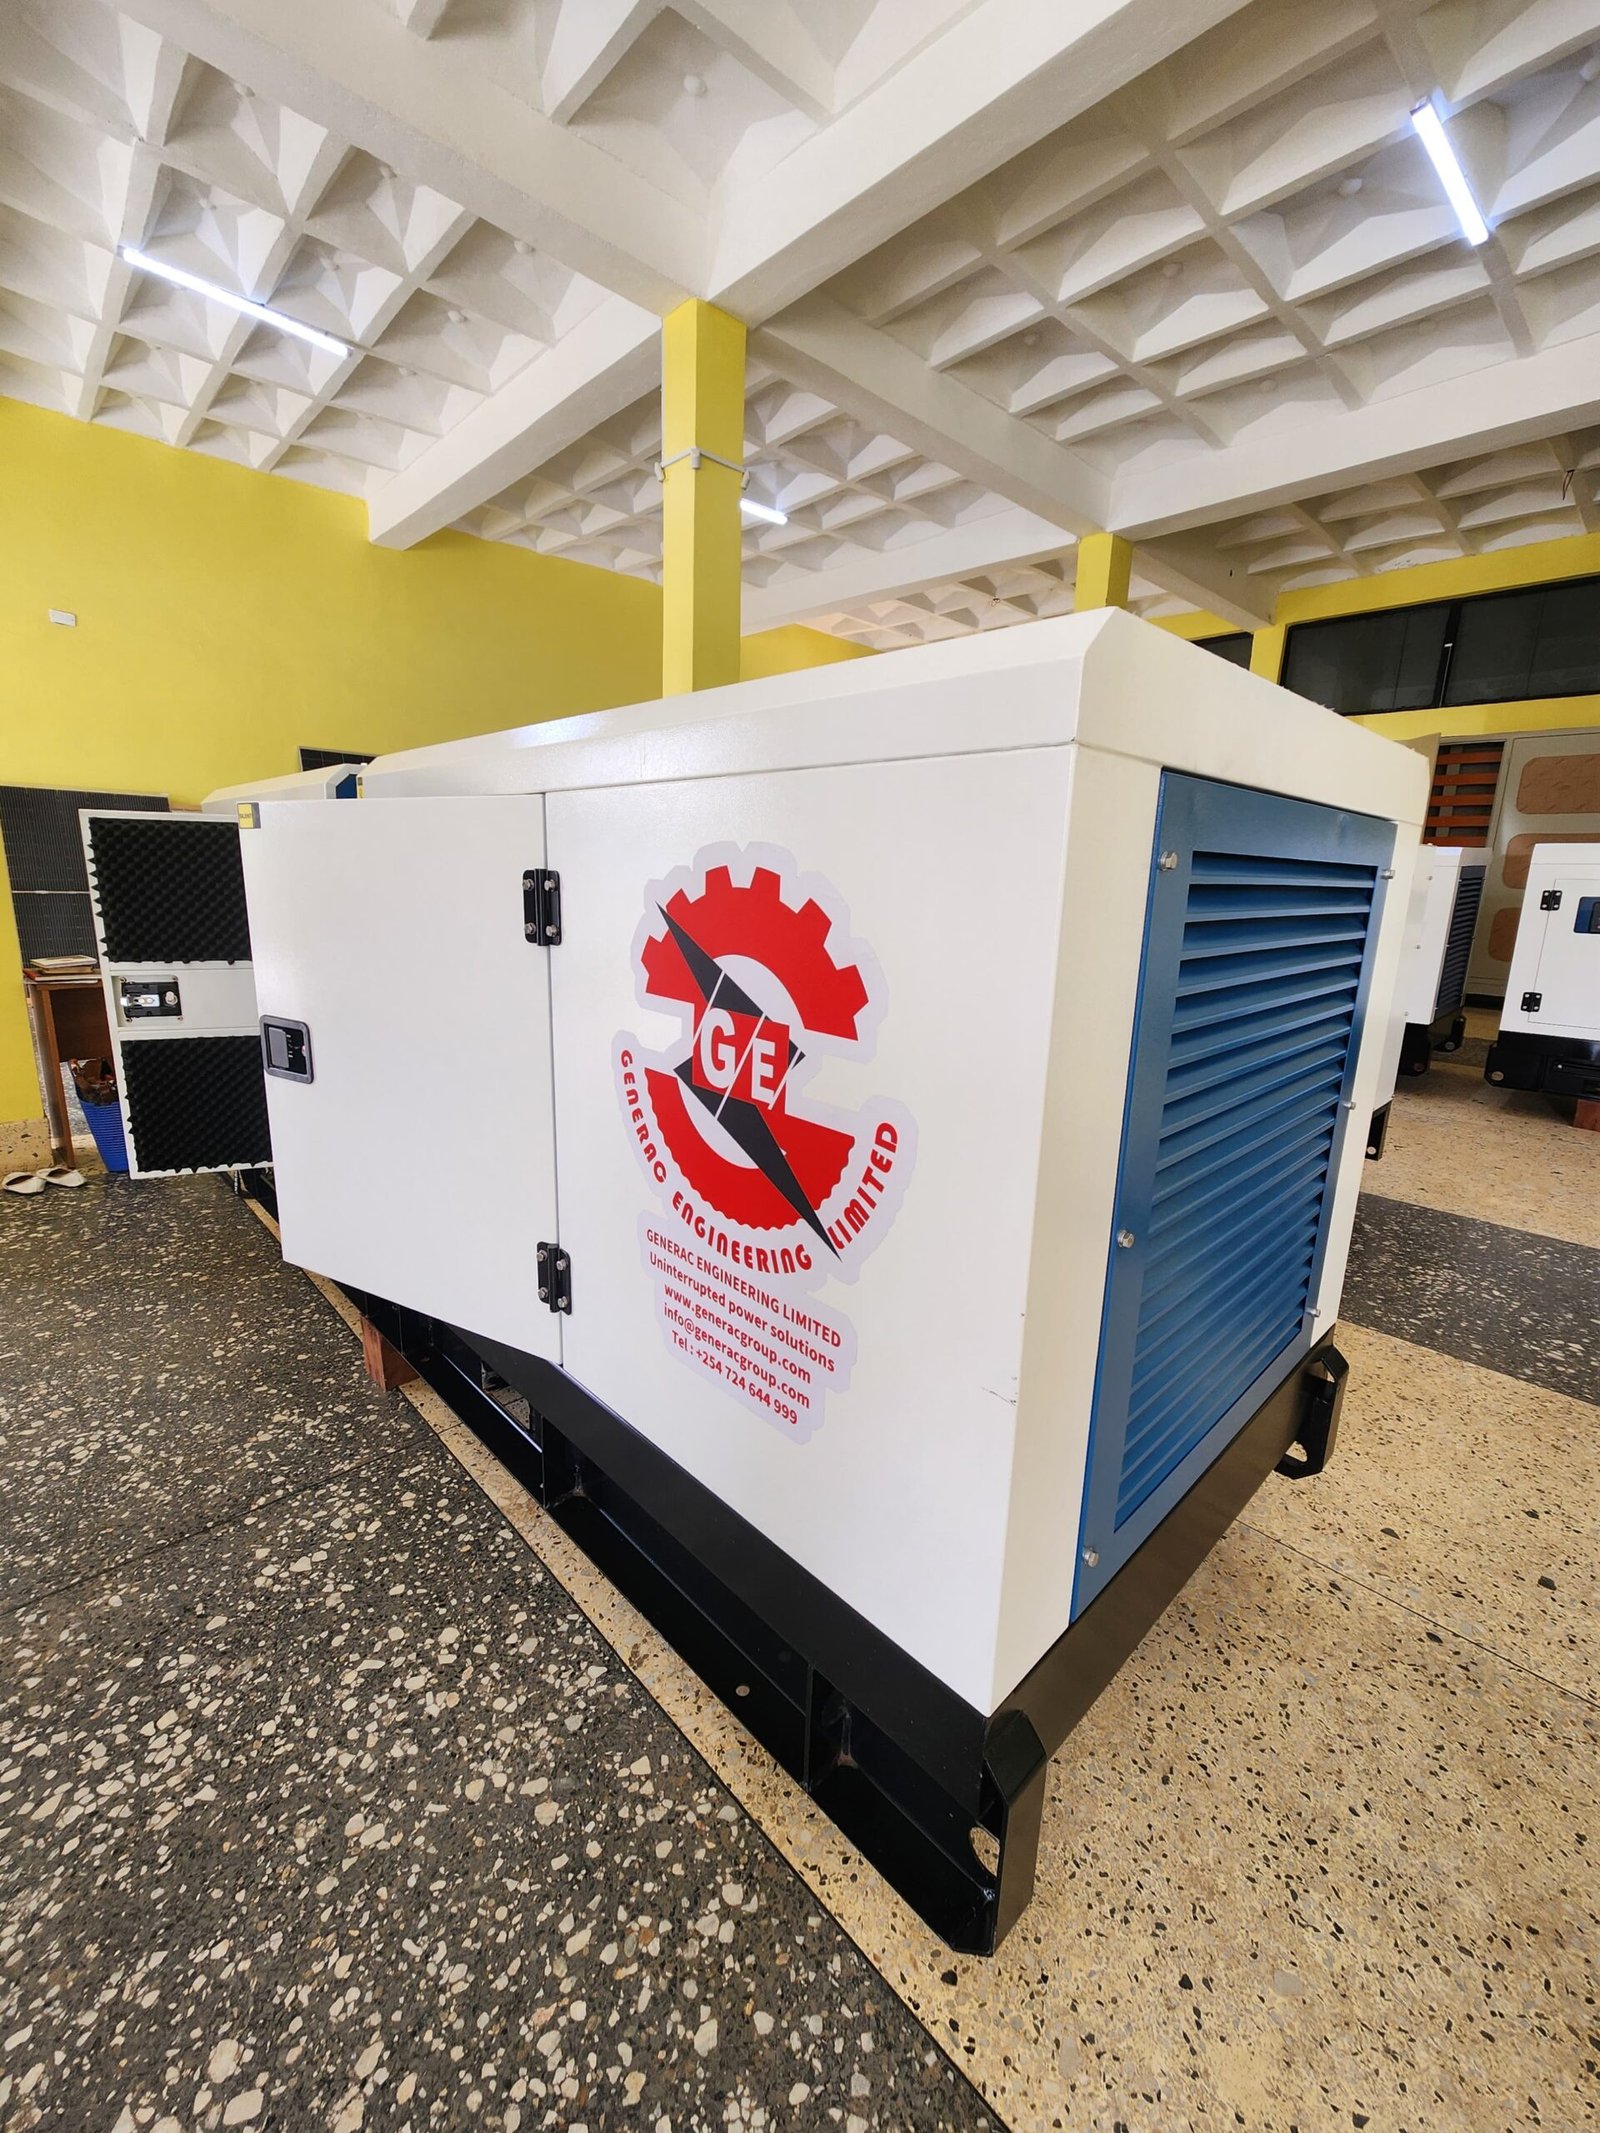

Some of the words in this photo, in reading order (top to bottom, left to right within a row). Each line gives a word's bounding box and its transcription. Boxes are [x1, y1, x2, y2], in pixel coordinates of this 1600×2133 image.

[620, 1049, 667, 1183] GENERAC
[671, 1190, 812, 1274] ENGINEERING
[826, 1122, 899, 1250] LIMITED
[646, 1229, 694, 1265] GENERAC
[697, 1256, 779, 1314] ENGINEERING
[783, 1304, 841, 1347] LIMITED
[650, 1251, 725, 1307] Uninterrupted
[729, 1301, 768, 1331] power
[770, 1326, 835, 1372] solutions
[664, 1284, 811, 1384] www.generacgroup.com
[664, 1302, 810, 1408] info@generacgroup.com
[696, 1349, 722, 1375] +254
[725, 1366, 746, 1390] 724
[748, 1382, 771, 1407] 644
[774, 1399, 798, 1424] 999
